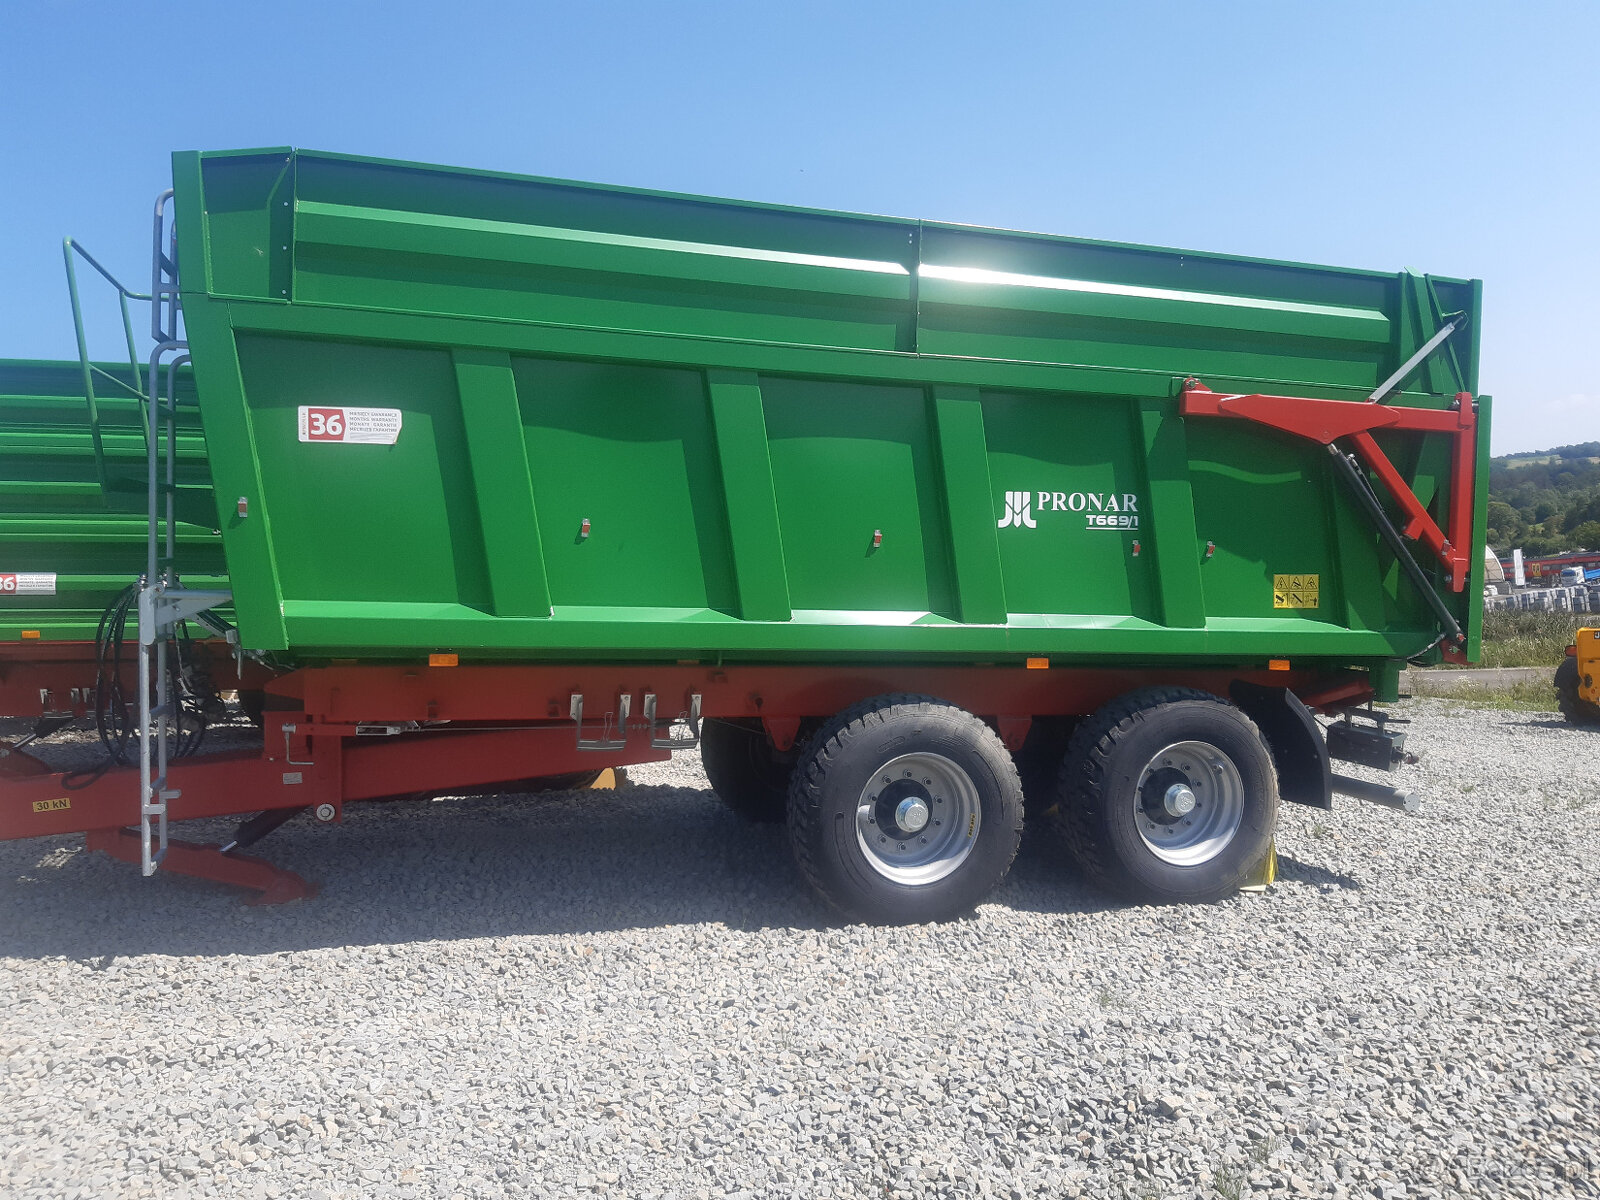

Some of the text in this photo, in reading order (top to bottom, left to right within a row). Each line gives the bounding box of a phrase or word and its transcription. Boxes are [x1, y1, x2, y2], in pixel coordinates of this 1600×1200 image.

[310, 413, 343, 436] 36
[1037, 491, 1138, 513] PRONAR
[1085, 514, 1139, 528] T669/1
[36, 799, 67, 811] 30 kN
